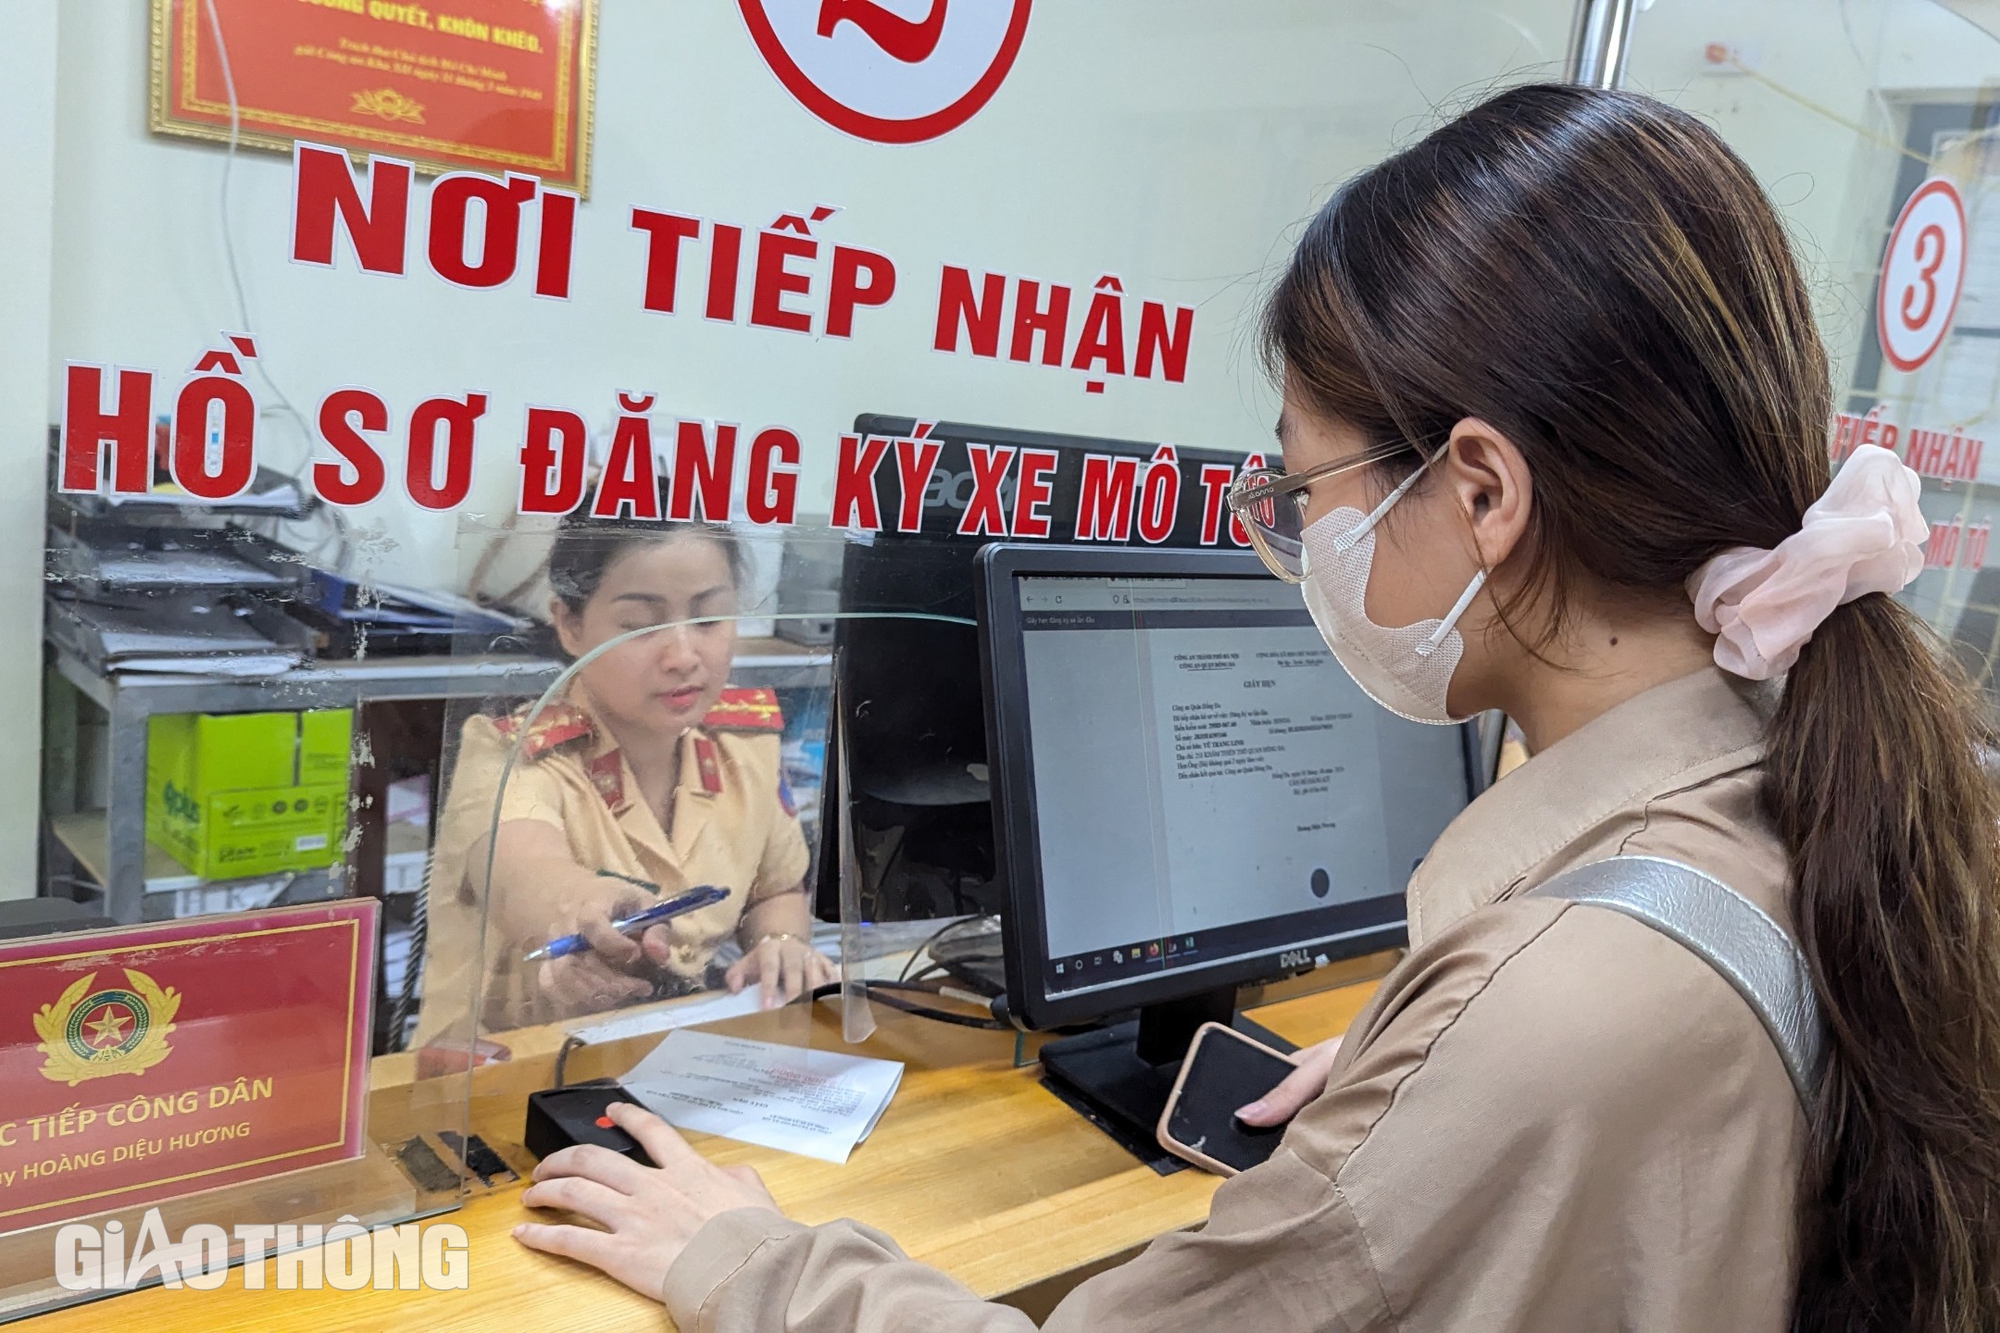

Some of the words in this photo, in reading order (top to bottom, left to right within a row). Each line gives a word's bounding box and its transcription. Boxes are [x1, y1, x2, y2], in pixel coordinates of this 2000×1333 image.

[291, 142, 578, 299] NƠI
[631, 204, 896, 338] TIẾP
[933, 275, 1194, 393] NHẬN
[1900, 224, 1945, 331] 3
[61, 334, 258, 499] HỒ
[313, 388, 488, 509] SƠ
[519, 392, 801, 525] ĐĂNG
[831, 422, 938, 532] KÝ
[958, 444, 1058, 537] XE
[1078, 447, 1179, 543] MÔ
[1905, 427, 1984, 488] NHẬN
[923, 468, 1020, 511] acr
[23, 1150, 106, 1181] HOÀNG
[113, 1138, 162, 1162] DIỆU
[169, 1122, 251, 1152] HƯƠNG
[27, 1102, 97, 1141] TIẾP
[107, 1095, 199, 1127] CÔNG
[209, 1077, 273, 1109] DÂN
